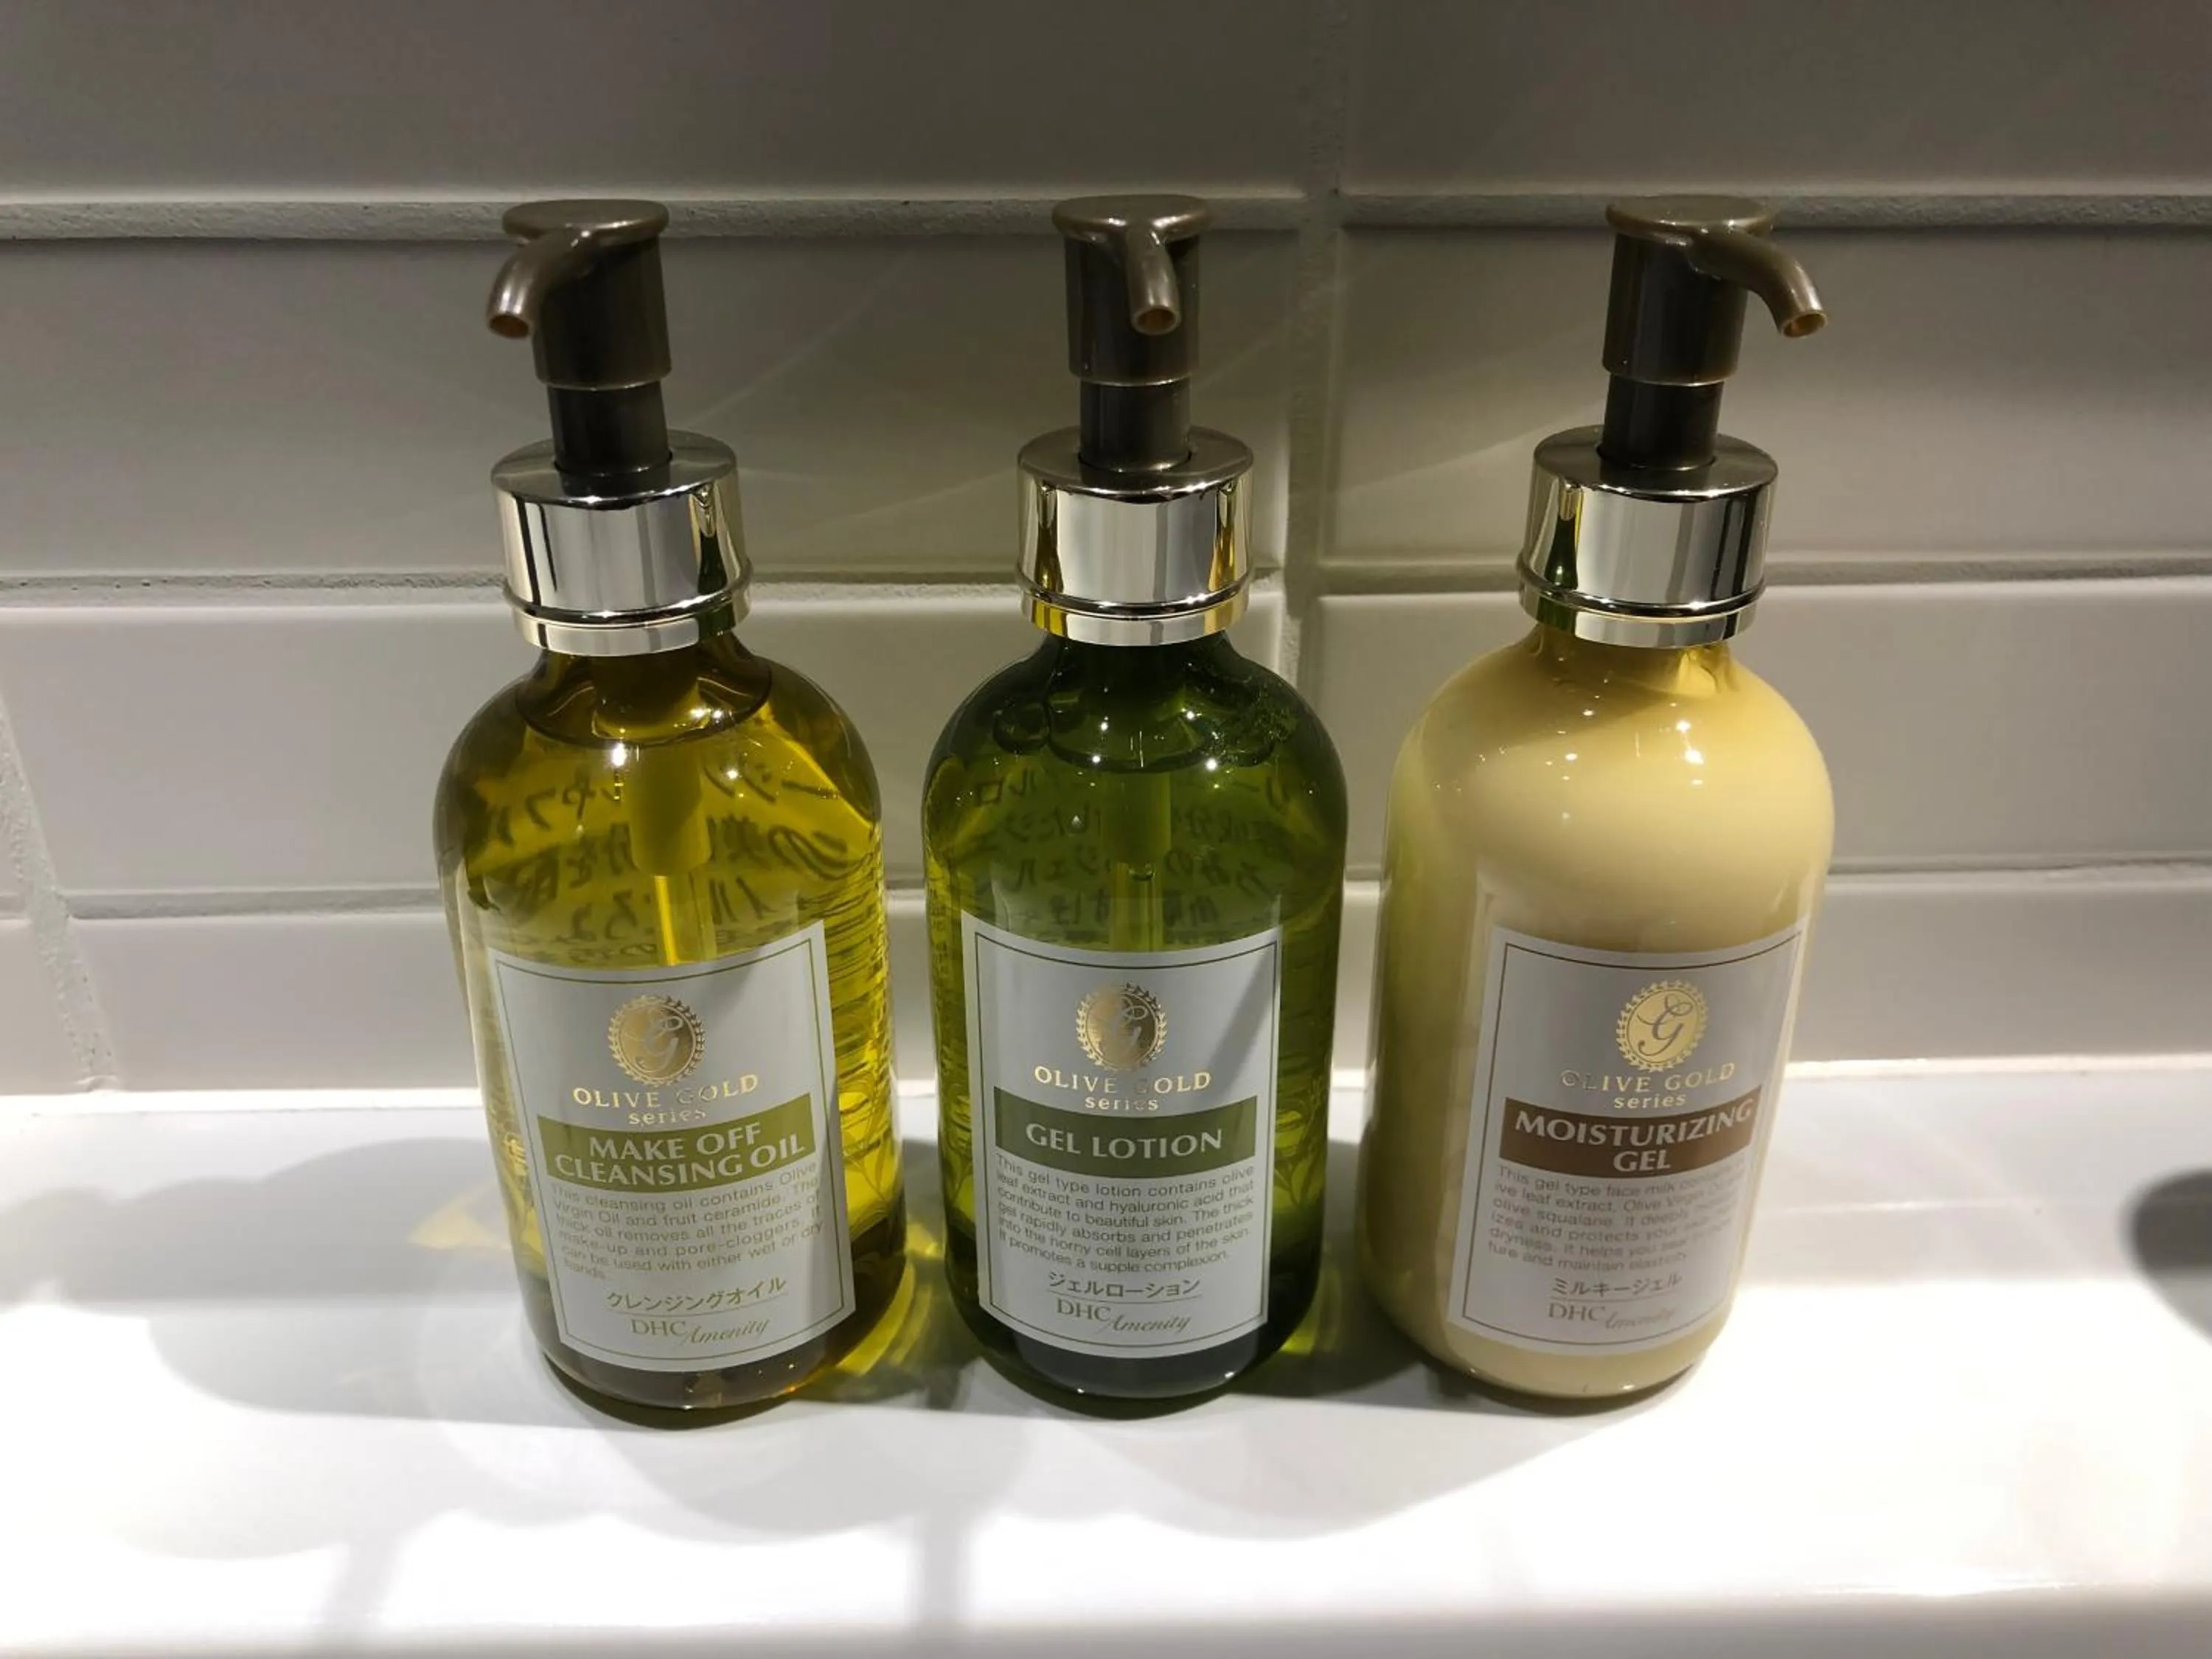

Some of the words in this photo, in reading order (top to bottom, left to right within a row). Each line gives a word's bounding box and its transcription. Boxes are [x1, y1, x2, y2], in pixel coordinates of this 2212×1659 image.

[573, 1087, 661, 1108] OLIVE
[675, 1074, 759, 1105] GOLD
[1034, 1065, 1118, 1094] OLIVE
[1133, 1071, 1212, 1094] GOLD
[1560, 1070, 1652, 1093] OLIVE
[1664, 1062, 1735, 1091] GOLD
[628, 1107, 707, 1126] series
[1085, 1096, 1159, 1111] series
[1614, 1093, 1687, 1109] series
[1515, 1098, 1753, 1147] MOISTURIZING
[589, 1136, 685, 1161] MAKE
[695, 1122, 762, 1155] OFF
[1025, 1122, 1082, 1154] GEL
[1092, 1128, 1223, 1160] LOTION
[555, 1150, 742, 1188] CLEANSING
[750, 1133, 806, 1169] OIL
[993, 1152, 1023, 1176] This
[1028, 1171, 1050, 1186] gel
[1055, 1177, 1091, 1194] type
[1096, 1183, 1142, 1198] lotion
[1148, 1178, 1216, 1197] contains
[1222, 1166, 1255, 1185] olive
[1613, 1150, 1672, 1172] GEL
[585, 1194, 666, 1214] cleansing
[673, 1196, 693, 1210] oil
[700, 1180, 773, 1207] contains
[779, 1161, 818, 1186] Olive
[1498, 1164, 1530, 1185] This
[1534, 1178, 1559, 1192] gel
[1564, 1181, 1602, 1197] type
[1523, 1187, 1551, 1205] leaf
[553, 1197, 594, 1220] Virgin
[597, 1210, 620, 1225] Oil
[625, 1214, 657, 1227] and
[663, 1212, 697, 1227] fruit
[998, 1186, 1062, 1219] contribute
[1065, 1209, 1081, 1222] to
[1085, 1211, 1149, 1228] beautiful
[1192, 1208, 1220, 1222] The
[1222, 1194, 1255, 1214] thick
[1022, 1183, 1072, 1206] extract
[1075, 1197, 1105, 1211] and
[1110, 1198, 1189, 1215] hyaluronic
[1194, 1188, 1225, 1208] acid
[1229, 1179, 1255, 1198] that
[1492, 1197, 1531, 1216] olive
[594, 1225, 613, 1238] oil
[617, 1230, 691, 1242] removes
[696, 1224, 715, 1239] all
[720, 1220, 748, 1236] the
[752, 1200, 802, 1226] traces
[1020, 1211, 1067, 1237] rapidly
[1072, 1227, 1136, 1243] absorbs
[1141, 1230, 1172, 1243] and
[1175, 1211, 1253, 1242] penetrates
[1529, 1225, 1563, 1238] and
[1568, 1229, 1639, 1244] protects
[635, 1245, 668, 1258] and
[655, 1258, 692, 1273] with
[696, 1251, 742, 1270] either
[748, 1239, 776, 1260] wet
[1009, 1237, 1073, 1267] promotes
[1077, 1257, 1086, 1269] a
[1090, 1261, 1141, 1275] supple
[1025, 1226, 1046, 1244] the
[1050, 1237, 1092, 1255] horny
[1096, 1246, 1121, 1258] cell
[1126, 1245, 1172, 1260] layers
[1175, 1241, 1192, 1254] of
[1195, 1237, 1219, 1253] the
[1522, 1253, 1554, 1267] and
[606, 1276, 787, 1312] クレンジングオイル
[1048, 1270, 1201, 1298] ジェルローション
[1551, 1273, 1683, 1298] ミルキージェル
[1056, 1297, 1113, 1321] DHC
[1101, 1312, 1192, 1335] Amenity
[1547, 1302, 1606, 1322] DHC
[630, 1318, 686, 1337] DHC
[681, 1317, 771, 1346] Amenity
